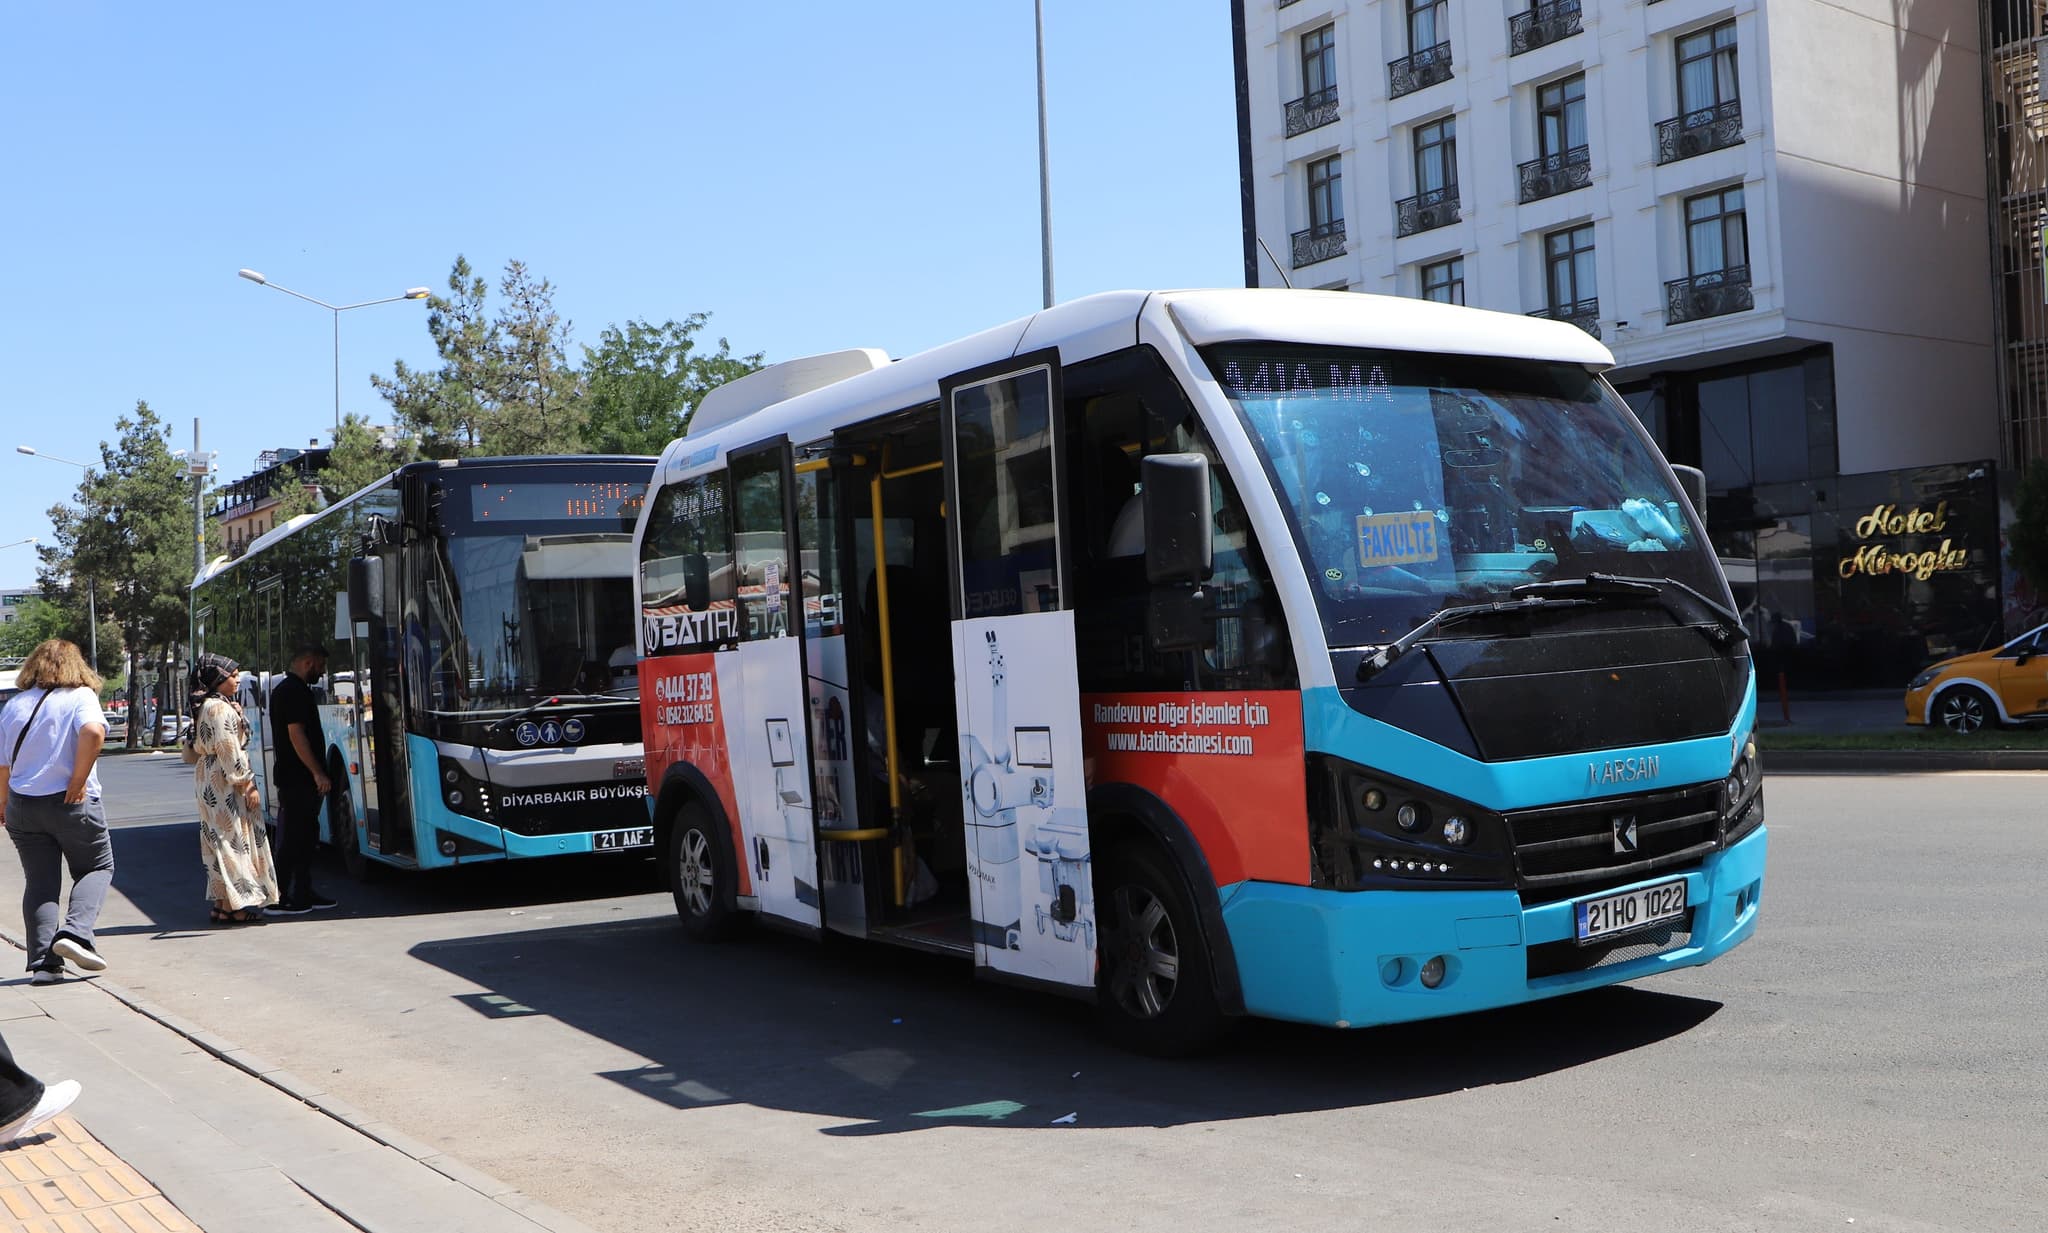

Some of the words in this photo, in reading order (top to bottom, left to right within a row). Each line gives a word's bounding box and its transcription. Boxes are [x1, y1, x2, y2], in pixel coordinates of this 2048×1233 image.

[1856, 500, 1947, 539] Hotel
[1362, 517, 1433, 558] FAKÜLTE
[665, 675, 685, 703] 444
[686, 674, 698, 702] 37
[699, 672, 713, 701] 39
[1094, 702, 1140, 723] Randevu
[1143, 705, 1157, 724] ve
[1158, 702, 1189, 728] Diğer
[1191, 699, 1242, 728] İşlemler
[1244, 698, 1269, 729] İçin
[1107, 730, 1253, 755] www.batihastanesi.com
[1589, 754, 1660, 785] KARSAN
[502, 790, 586, 807] DİYARBAKIR
[601, 833, 616, 848] 21
[623, 831, 644, 846] AAF
[1589, 902, 1609, 932] 21
[1613, 896, 1637, 927] HO
[1644, 885, 1683, 918] 1022
